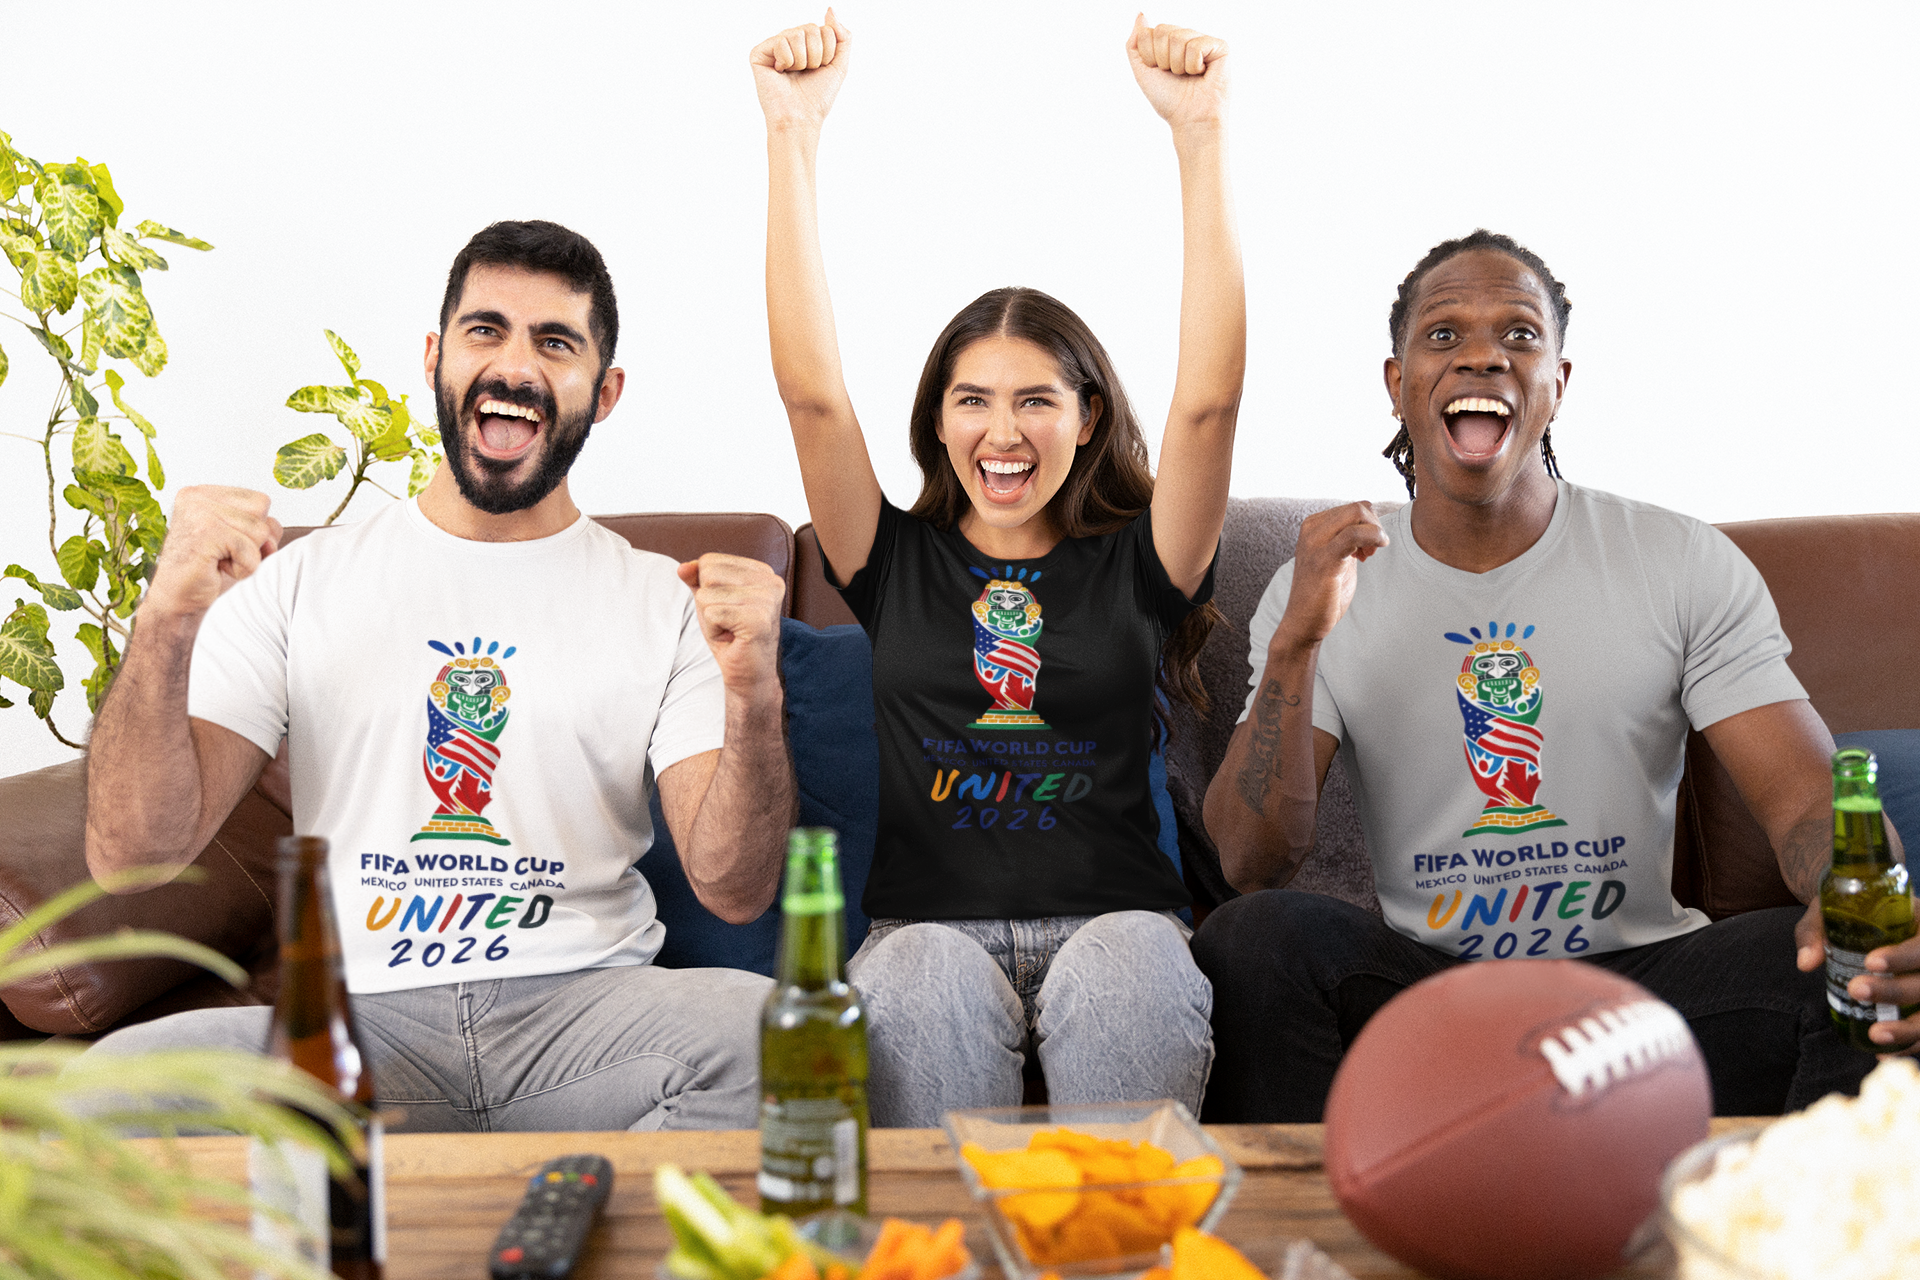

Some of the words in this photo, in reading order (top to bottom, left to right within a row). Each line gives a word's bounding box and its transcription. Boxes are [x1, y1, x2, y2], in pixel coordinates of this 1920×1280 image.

[923, 738, 967, 754] FIFA
[969, 739, 1049, 755] WORLD
[1054, 741, 1096, 754] CUP
[923, 755, 966, 766] MEXICO
[972, 758, 1008, 767] UNITED
[931, 769, 1093, 802] UNITED
[952, 806, 1056, 830] 2026
[361, 854, 409, 875] FIFA
[415, 854, 508, 872] WORLD
[514, 857, 564, 875] CUP
[1414, 853, 1468, 872] FIFA
[1472, 842, 1568, 868] WORLD
[1574, 836, 1626, 857] CUP
[361, 877, 406, 891] MEXICO
[415, 878, 458, 888] UNITED
[462, 878, 503, 886] STATES
[510, 879, 565, 891] CANADA
[1416, 874, 1466, 889] MEXICO
[1474, 870, 1521, 885] UNITED
[1525, 865, 1568, 876] STATES
[1574, 859, 1628, 873] CANADA
[366, 893, 554, 933] UNITED
[1427, 880, 1626, 930] UNITED
[388, 934, 509, 967] 2026
[1458, 924, 1589, 959] 2026
